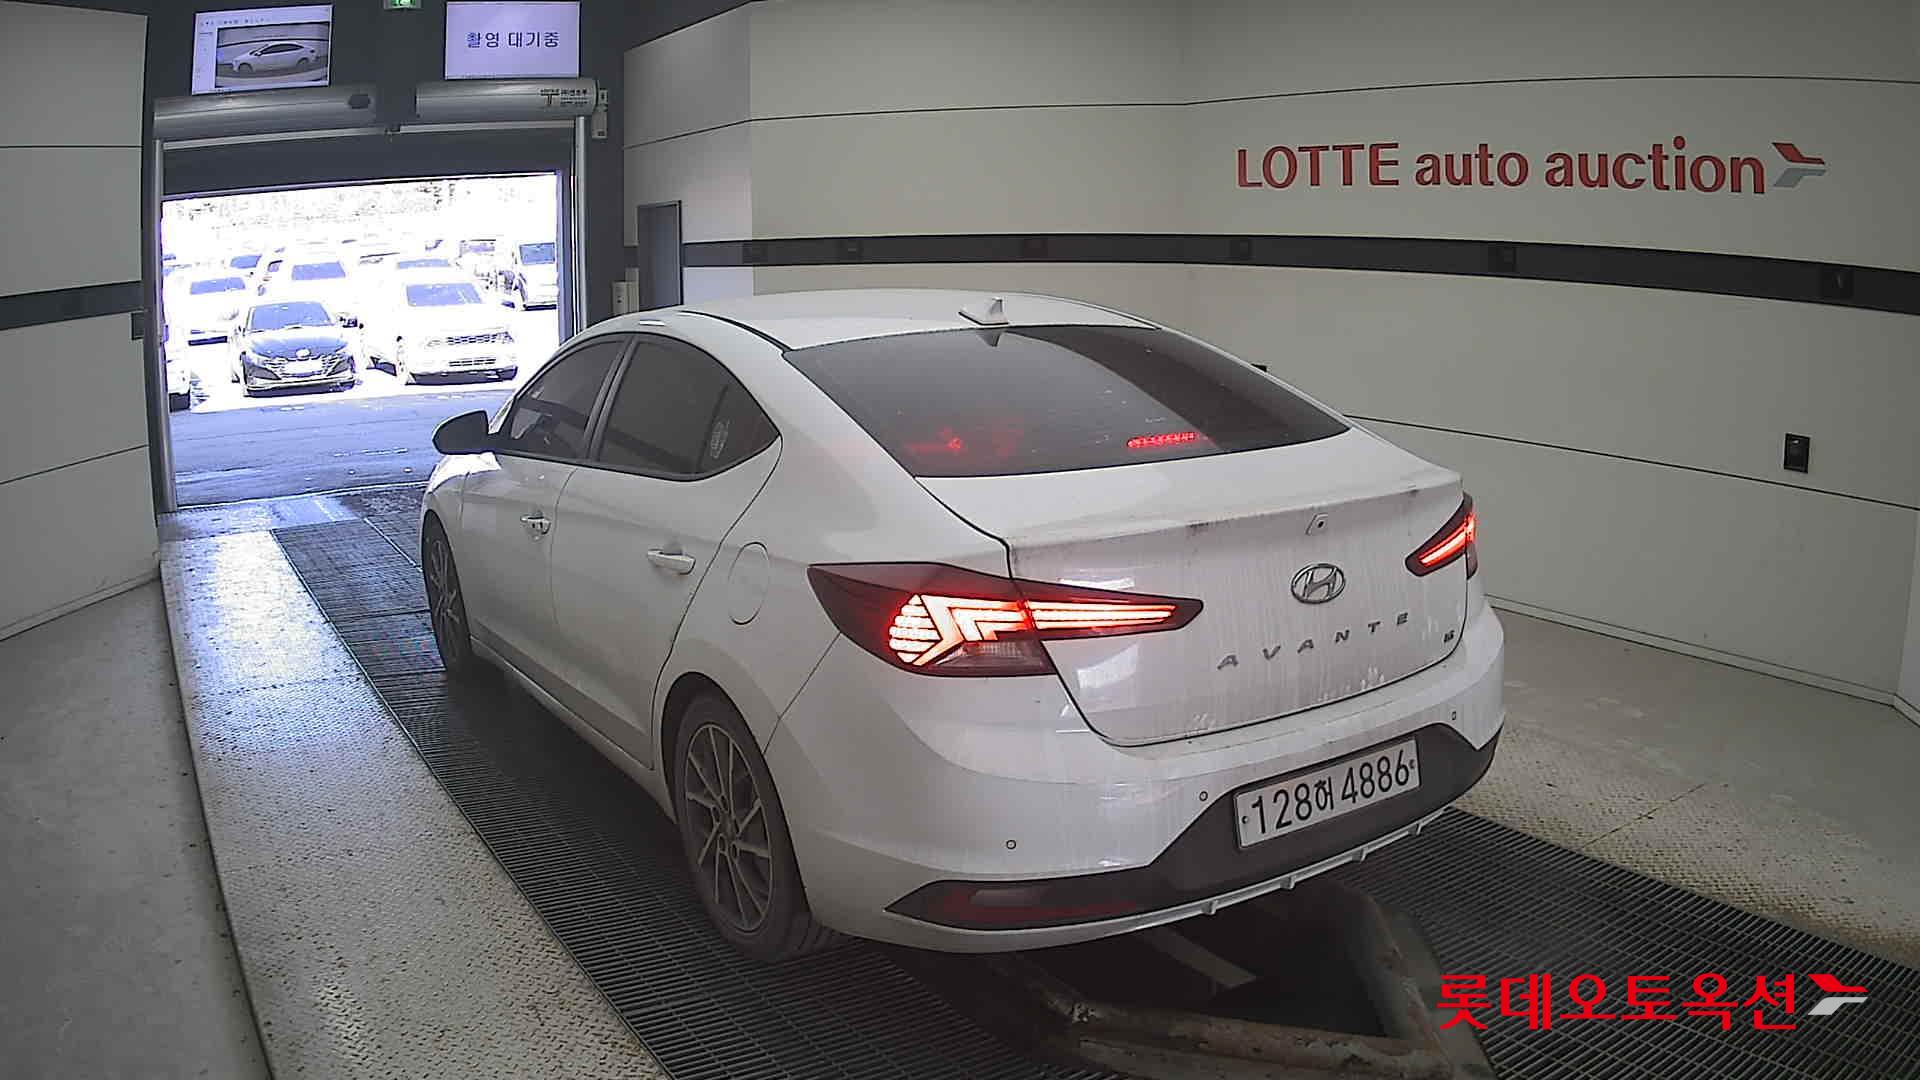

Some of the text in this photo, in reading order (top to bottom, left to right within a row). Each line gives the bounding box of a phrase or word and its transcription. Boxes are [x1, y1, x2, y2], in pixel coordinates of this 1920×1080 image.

[467, 32, 560, 48] 촬영 대기중
[1237, 136, 1765, 194] LOTTE auto auction
[1217, 612, 1408, 670] AVANTE
[1341, 749, 1410, 804] 4886
